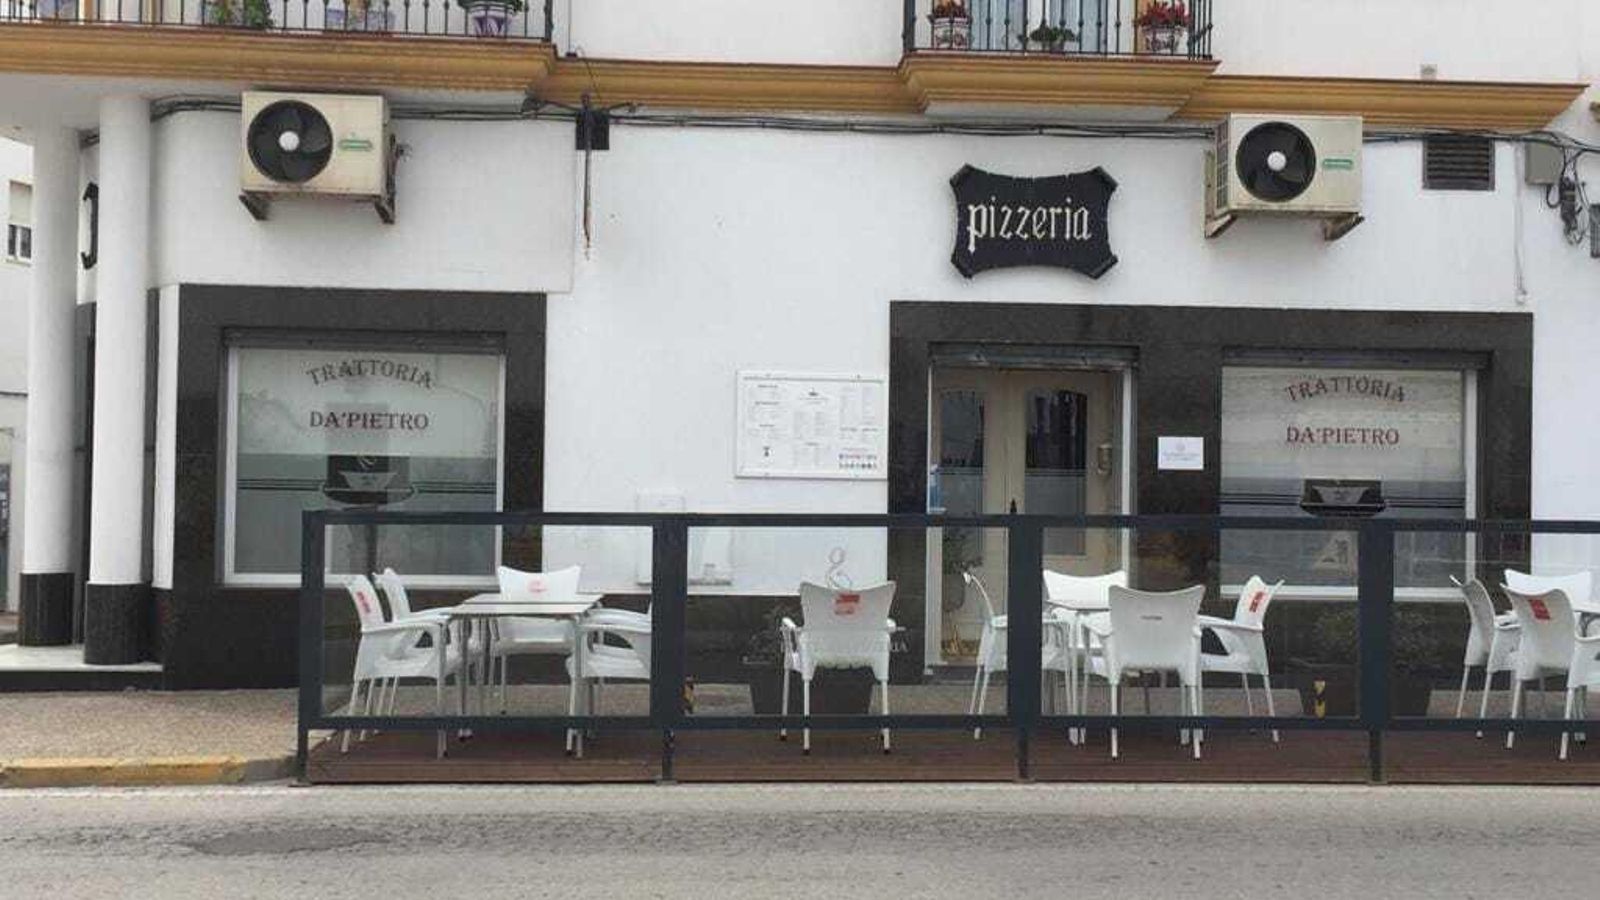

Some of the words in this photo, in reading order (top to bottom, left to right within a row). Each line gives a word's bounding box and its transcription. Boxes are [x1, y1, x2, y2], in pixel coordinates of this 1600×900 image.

[966, 196, 1092, 254] pizzeria
[305, 359, 431, 389] TRATTORIA
[1284, 376, 1405, 402] TRATTORIA
[310, 411, 429, 430] DA'PIETRO
[1286, 426, 1401, 445] DA'PIETRO
